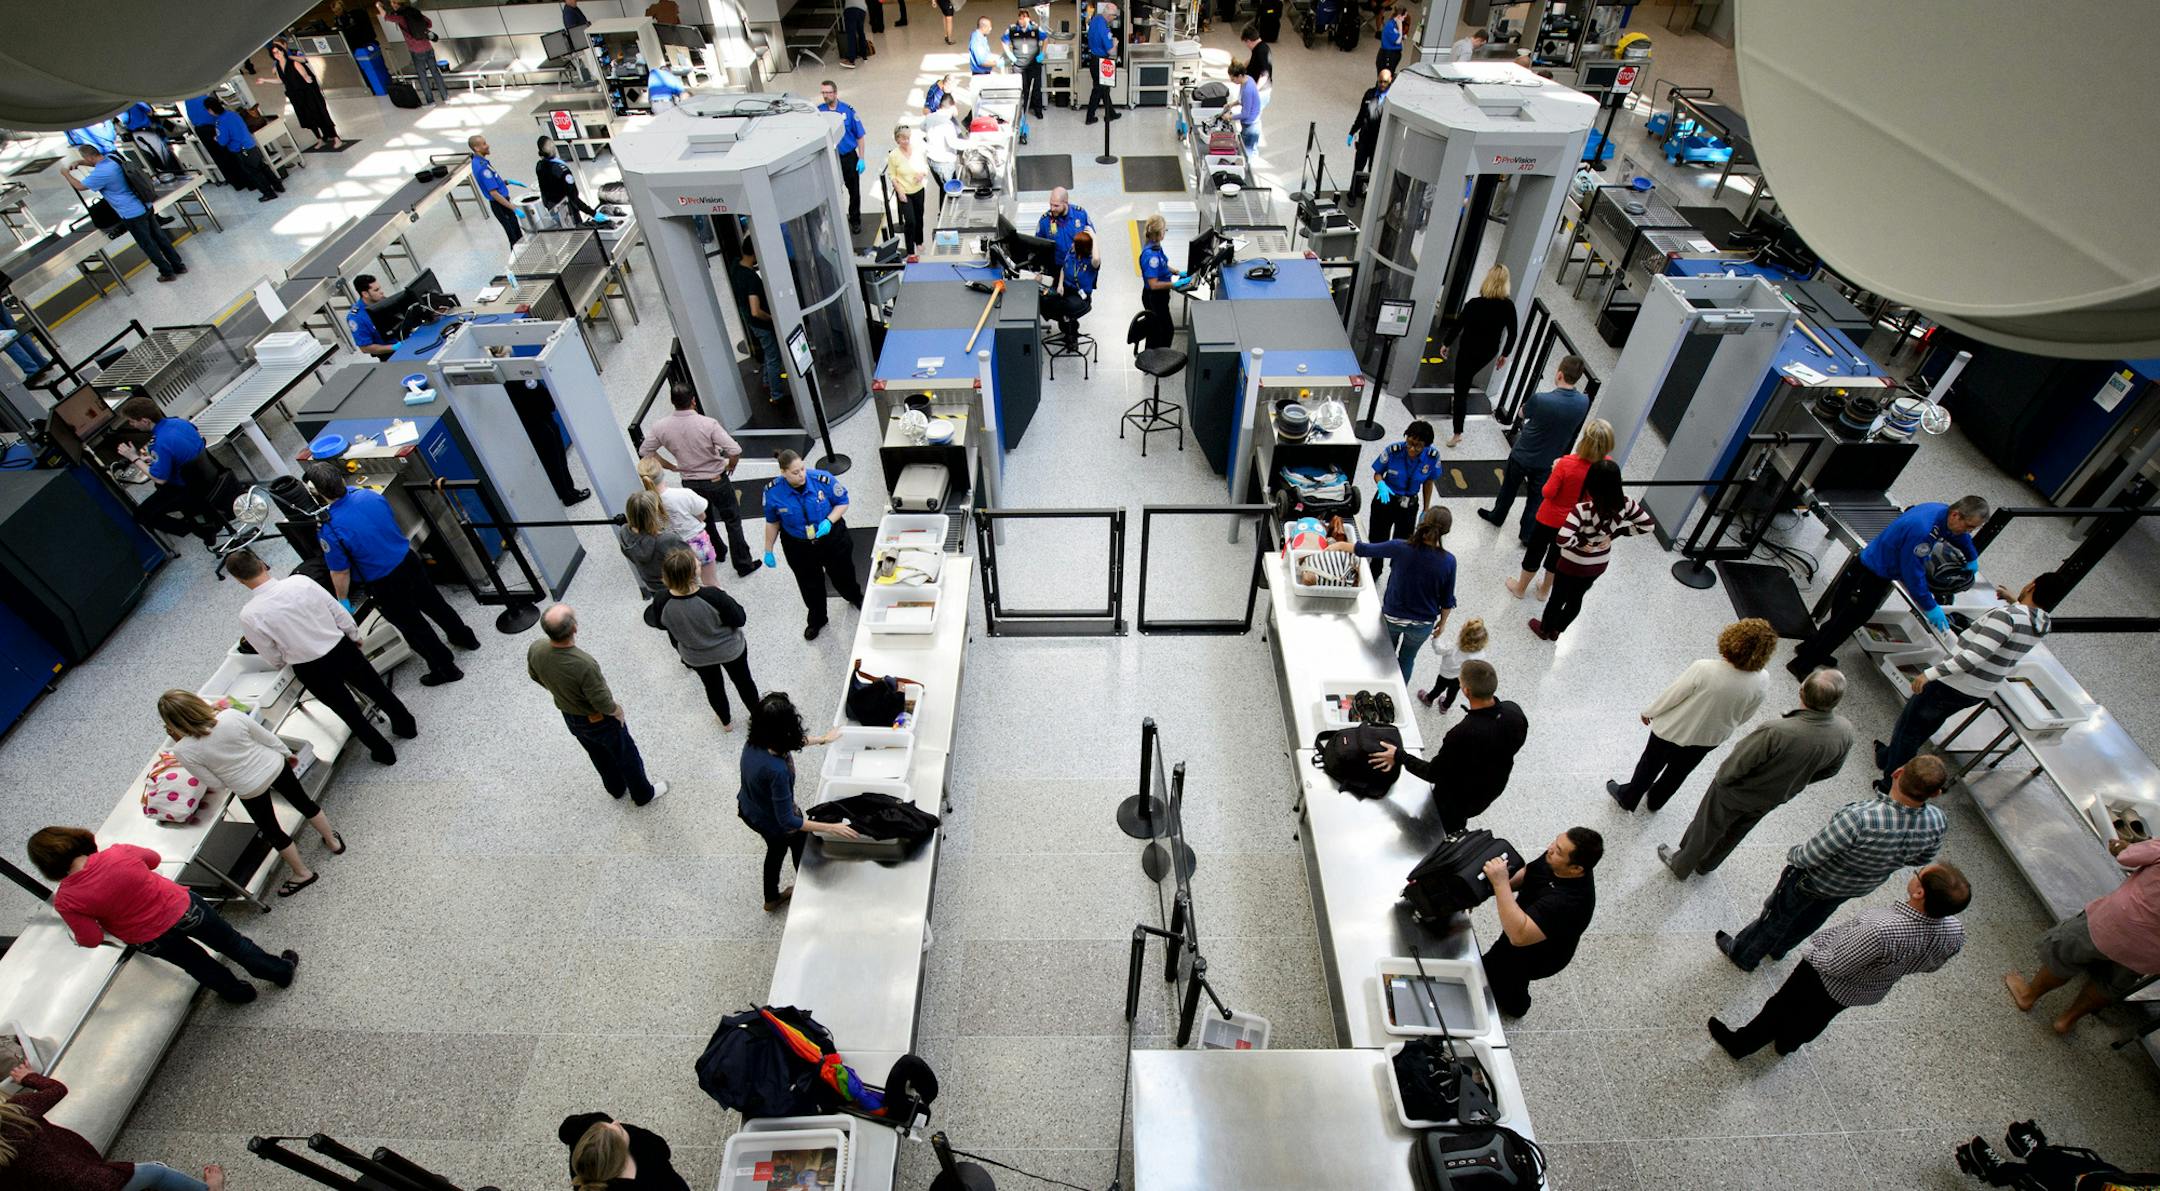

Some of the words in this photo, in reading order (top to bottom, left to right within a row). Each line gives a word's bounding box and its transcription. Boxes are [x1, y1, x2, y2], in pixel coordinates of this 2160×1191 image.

[1619, 72, 1635, 80] STOP
[554, 116, 570, 126] STOP
[1502, 156, 1536, 164] ProVision
[687, 196, 724, 204] ProVision
